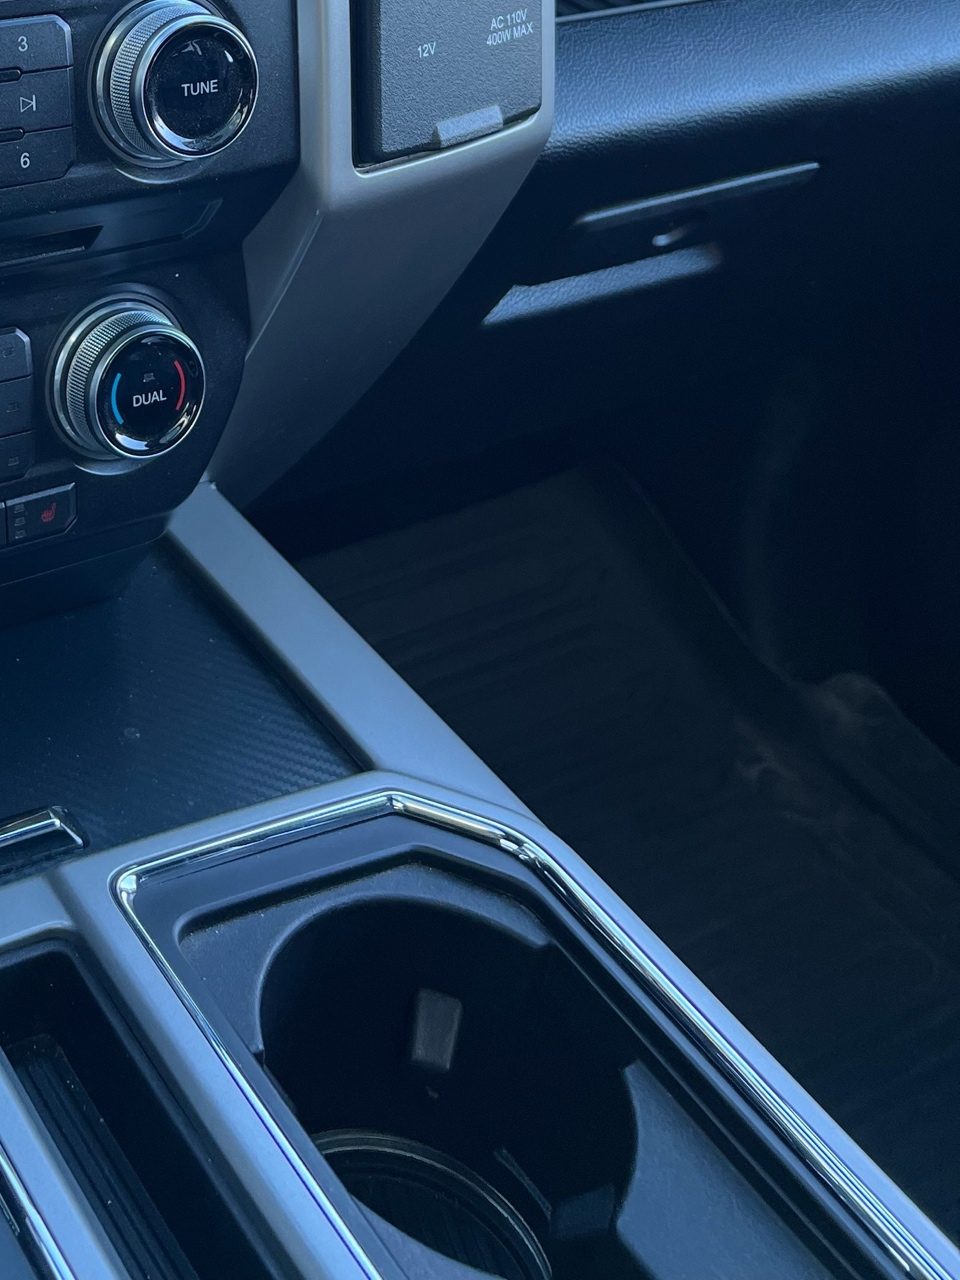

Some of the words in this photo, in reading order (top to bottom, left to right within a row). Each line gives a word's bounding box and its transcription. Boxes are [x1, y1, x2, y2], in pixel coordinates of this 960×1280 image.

[490, 16, 504, 31] AC
[506, 9, 528, 27] 110V
[486, 27, 512, 46] 400W
[513, 22, 533, 39] MAX
[17, 36, 28, 52] 3
[417, 42, 436, 58] 12V
[181, 79, 218, 97] TUNE
[20, 153, 30, 168] 6
[132, 389, 167, 407] DUAL
